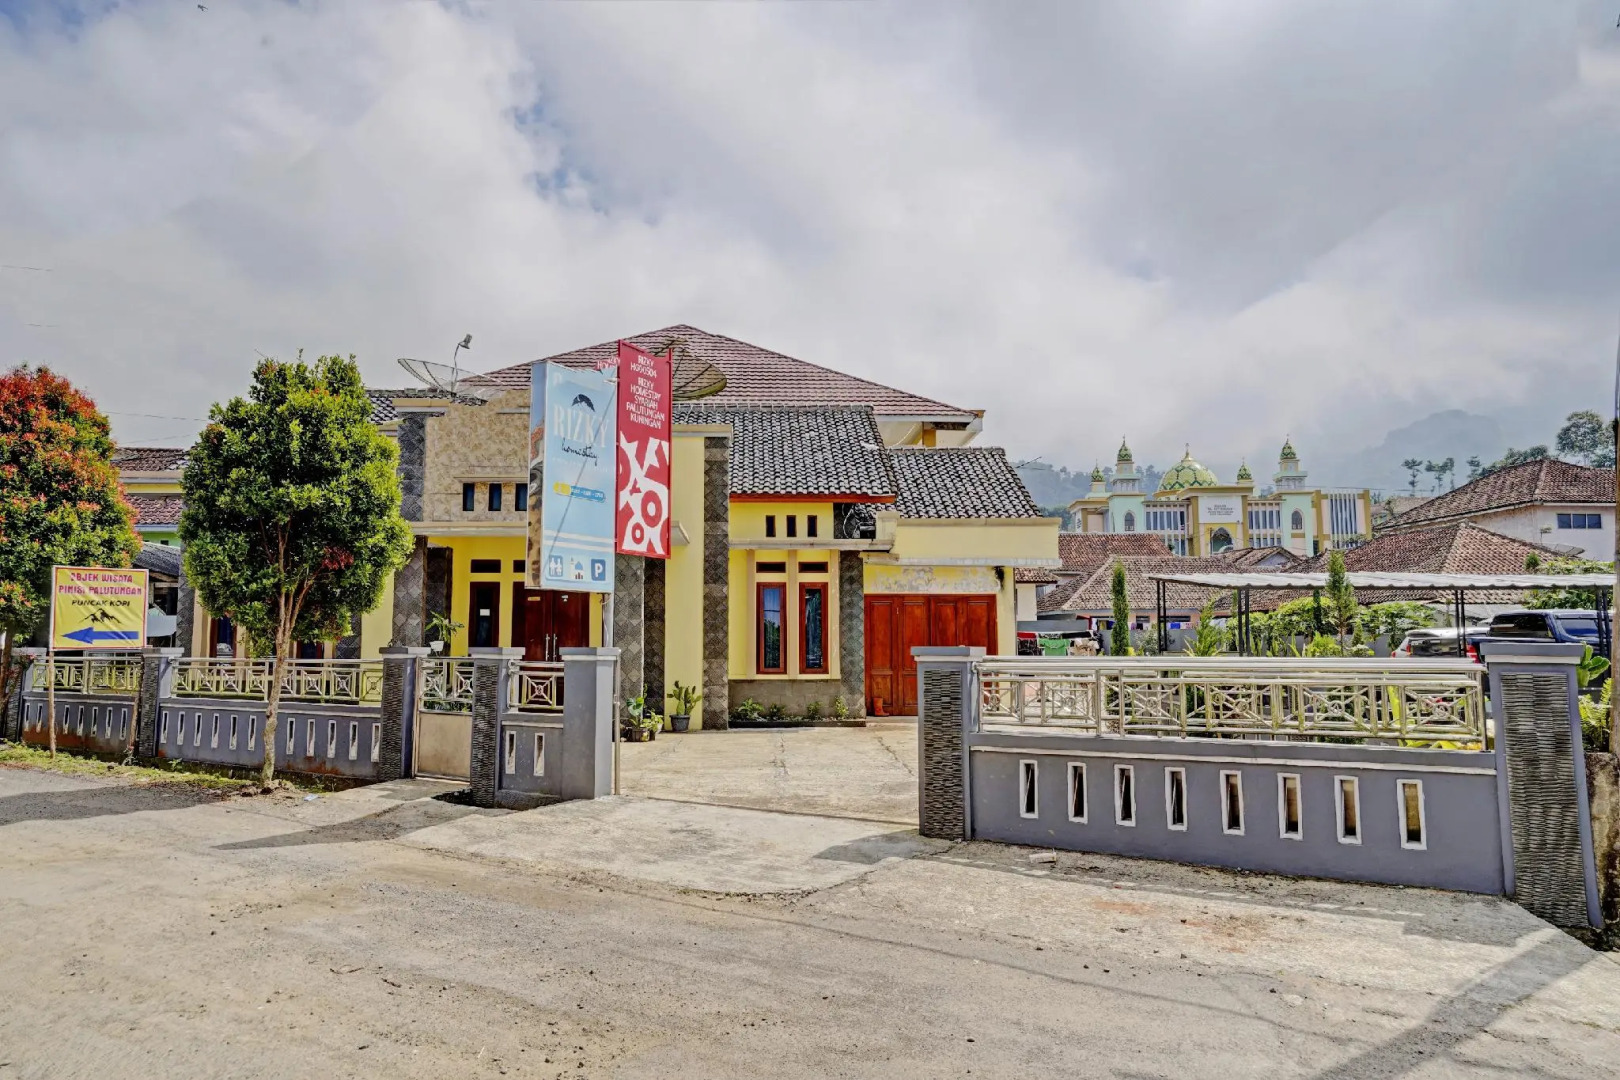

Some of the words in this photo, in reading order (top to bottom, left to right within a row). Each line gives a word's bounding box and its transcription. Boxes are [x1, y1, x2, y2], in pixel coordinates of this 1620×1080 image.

[630, 383, 662, 401] HOMESTAY
[634, 395, 658, 410] SYARIAH
[626, 401, 665, 421] PALUTUNGAN
[553, 403, 609, 448] RIZKY
[630, 412, 661, 429] KUNINGAN
[101, 573, 133, 583] WISATA
[88, 586, 142, 596] PALUTUNGAN
[71, 599, 107, 607] PUNCAK
